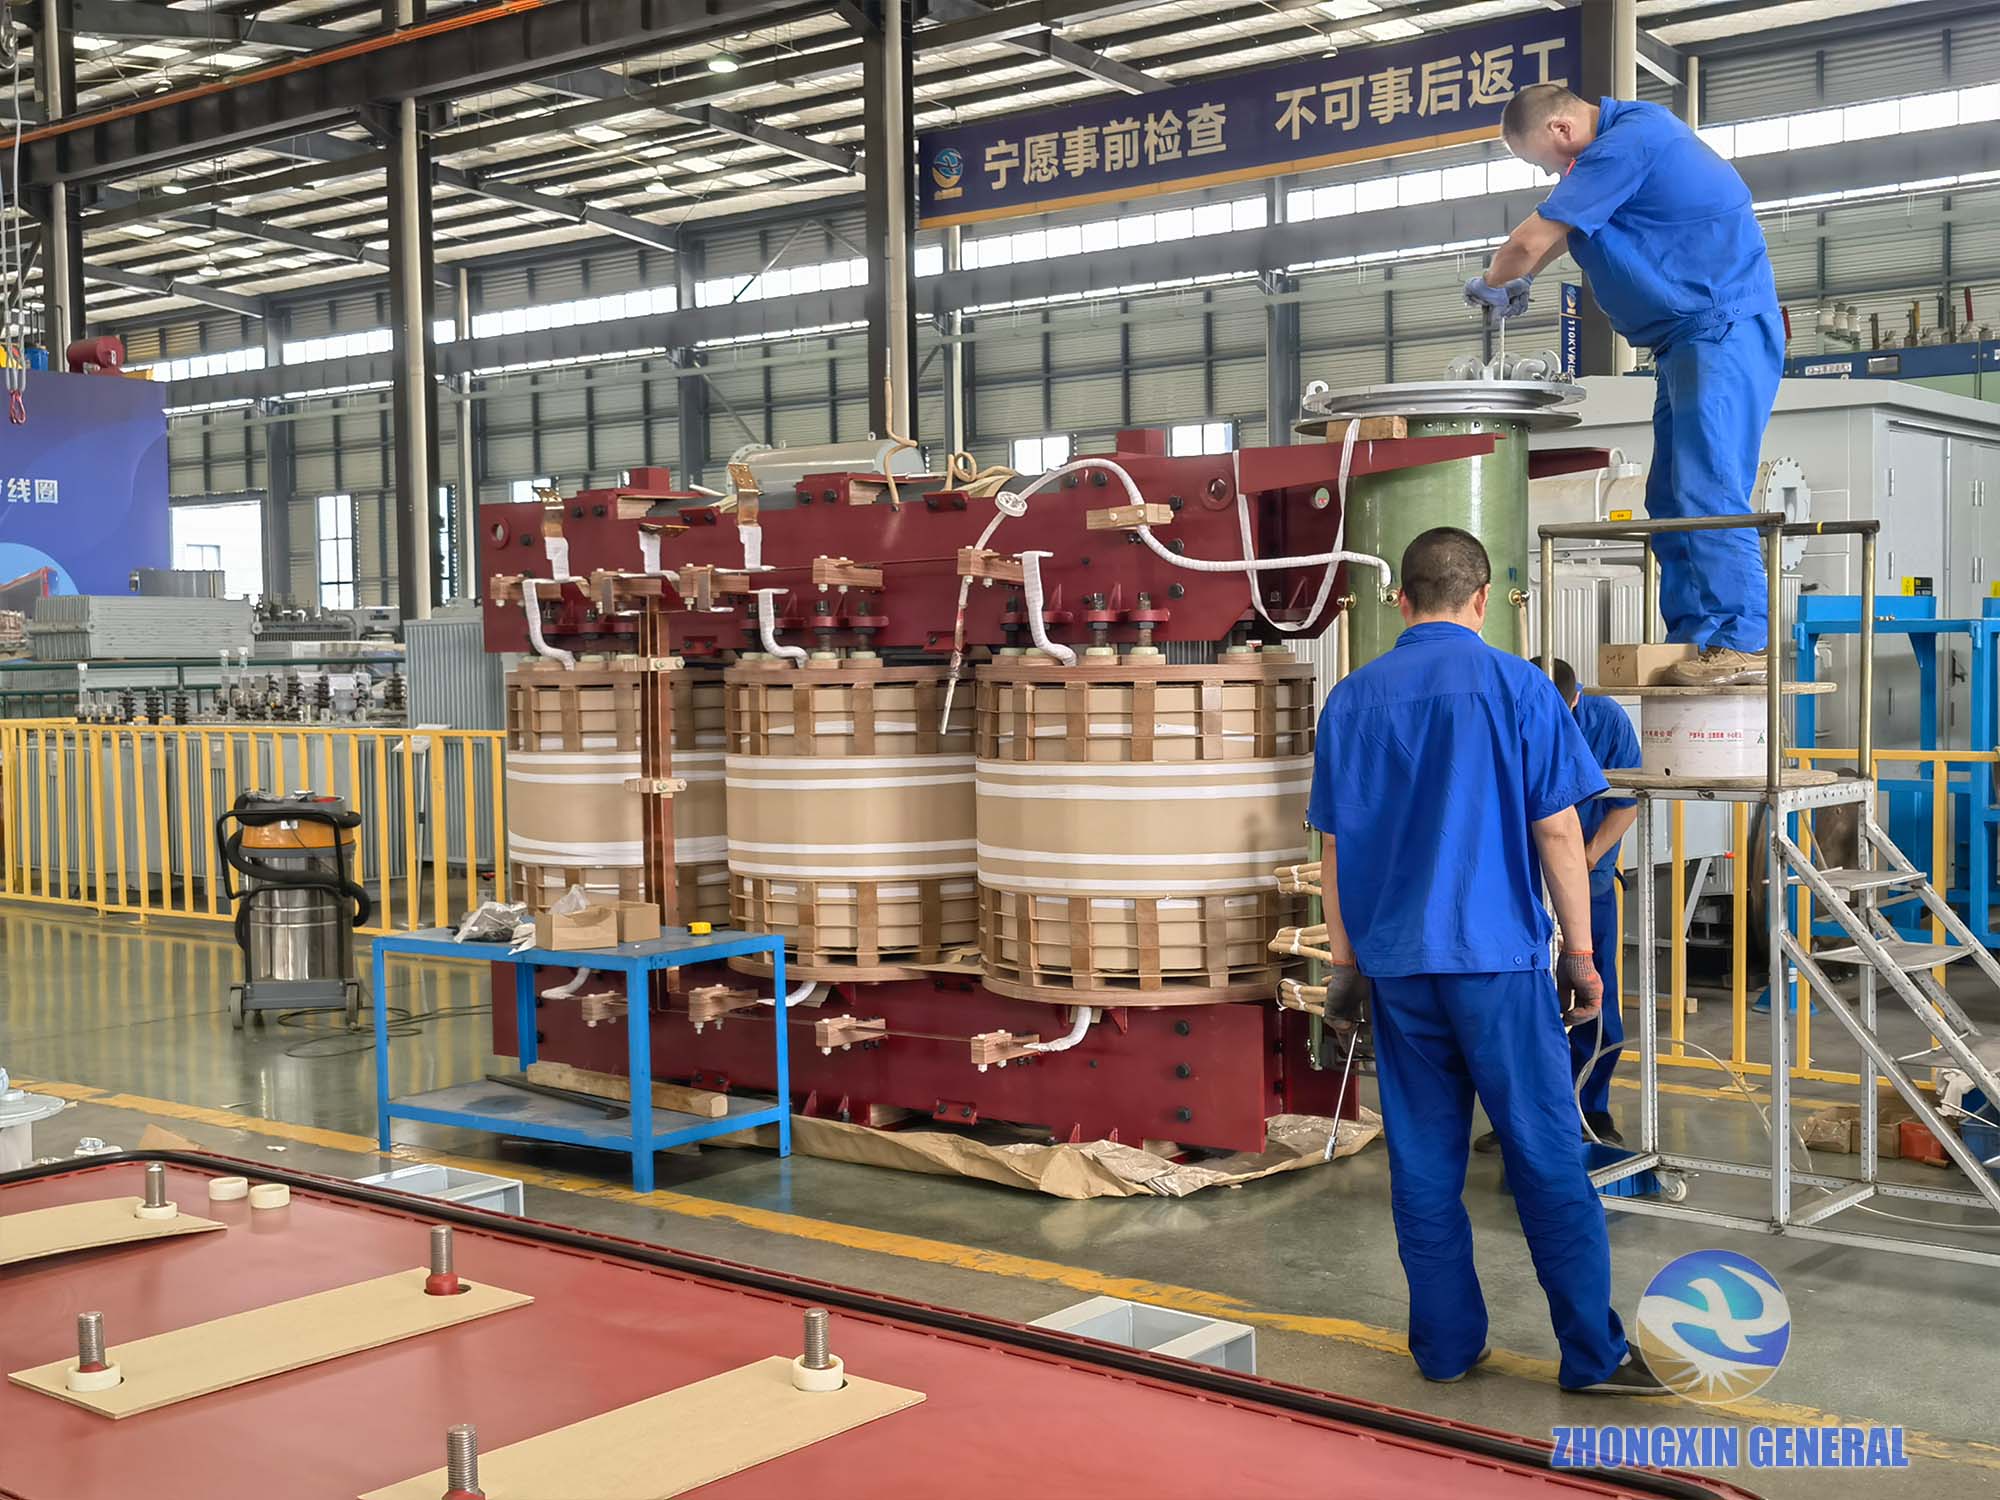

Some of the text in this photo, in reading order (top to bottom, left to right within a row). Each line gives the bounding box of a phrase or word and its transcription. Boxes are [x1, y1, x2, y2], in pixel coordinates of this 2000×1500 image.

[983, 38, 1568, 190] 宁愿事前检查 不可事后返工
[0, 478, 58, 504] 线圈
